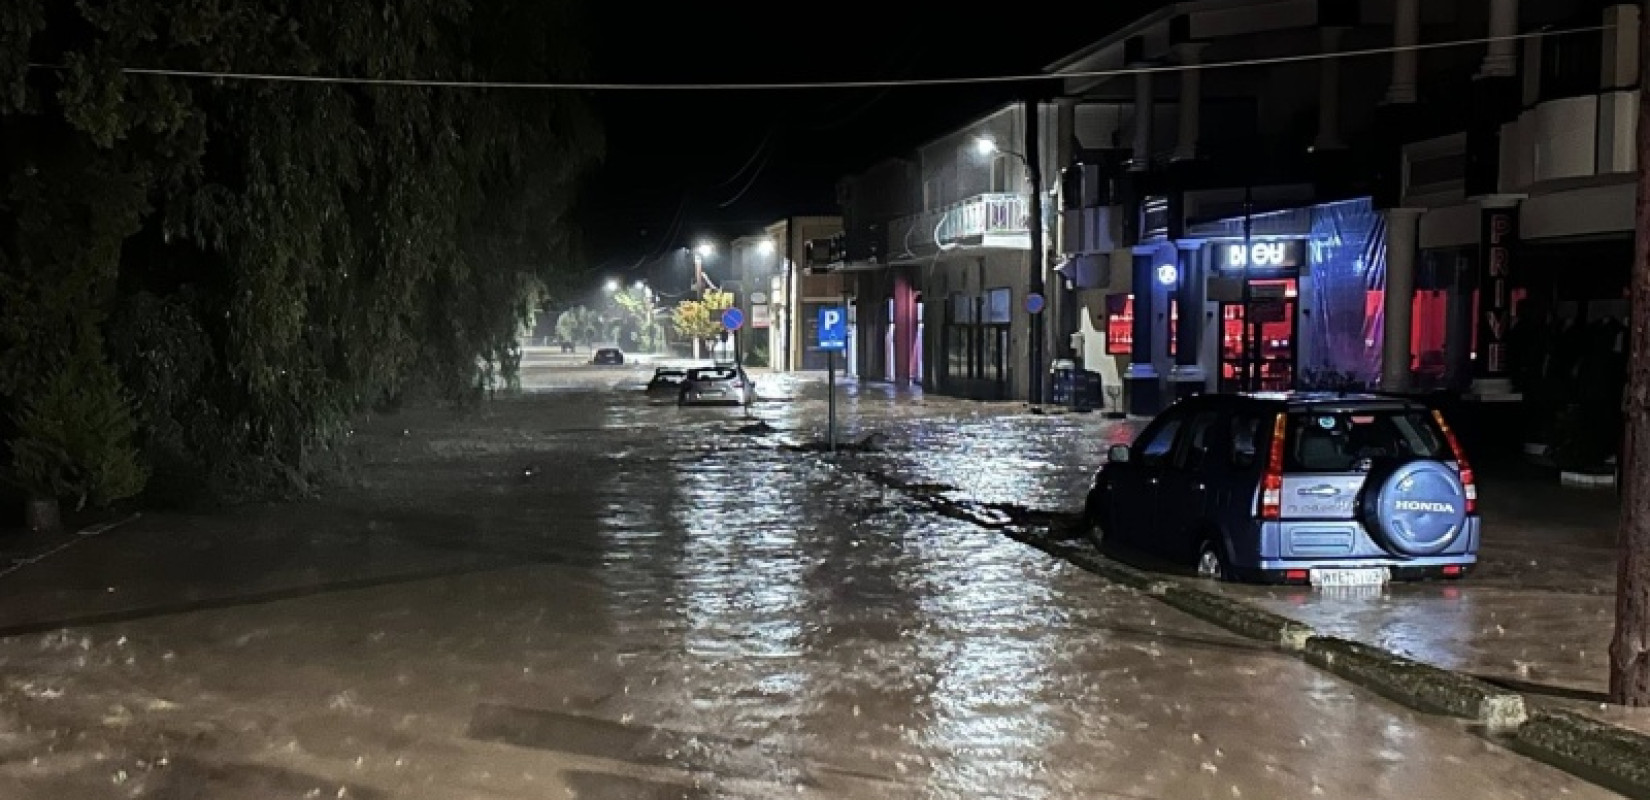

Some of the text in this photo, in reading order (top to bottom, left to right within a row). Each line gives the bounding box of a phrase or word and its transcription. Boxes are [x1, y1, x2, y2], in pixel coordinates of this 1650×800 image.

[1485, 213, 1512, 372] PRIVE
[825, 310, 840, 331] P
[1395, 500, 1455, 513] HONDA
